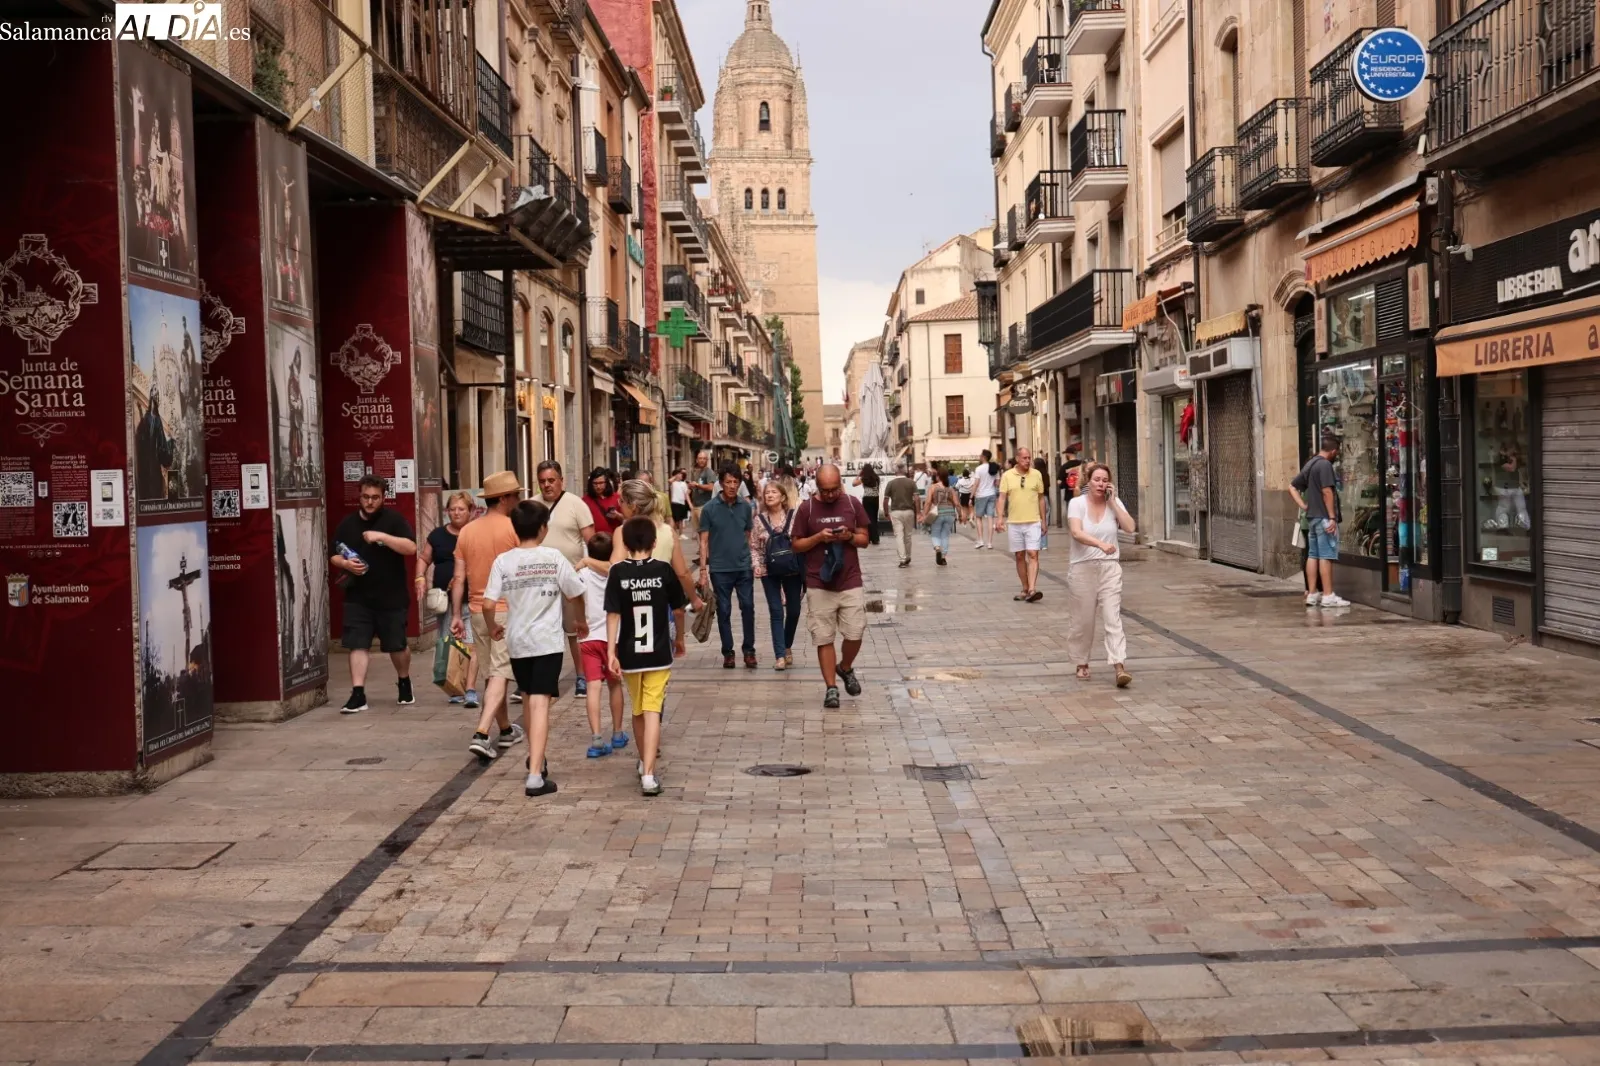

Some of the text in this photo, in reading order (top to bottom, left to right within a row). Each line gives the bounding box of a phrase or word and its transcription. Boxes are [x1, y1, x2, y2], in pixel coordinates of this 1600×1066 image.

[1370, 54, 1424, 64] EUROPA
[1497, 266, 1563, 303] LIBRERIA
[1474, 331, 1555, 366] LIBRERIA
[21, 357, 78, 375] Junta de
[0, 370, 85, 395] Semana
[217, 376, 231, 387] de
[203, 388, 236, 401] ana
[356, 395, 390, 405] Junta de
[15, 389, 85, 415] Santa
[205, 402, 237, 415] nta
[30, 408, 86, 418] de Salamanca
[341, 402, 393, 417] Semana
[353, 413, 394, 429] Santa
[846, 460, 883, 471] EL GAS
[32, 583, 89, 595] Ayuntamiento
[630, 577, 662, 590] SAGRES
[32, 594, 89, 604] de Salamanca
[632, 589, 651, 602] DINIS
[632, 606, 655, 653] 9
